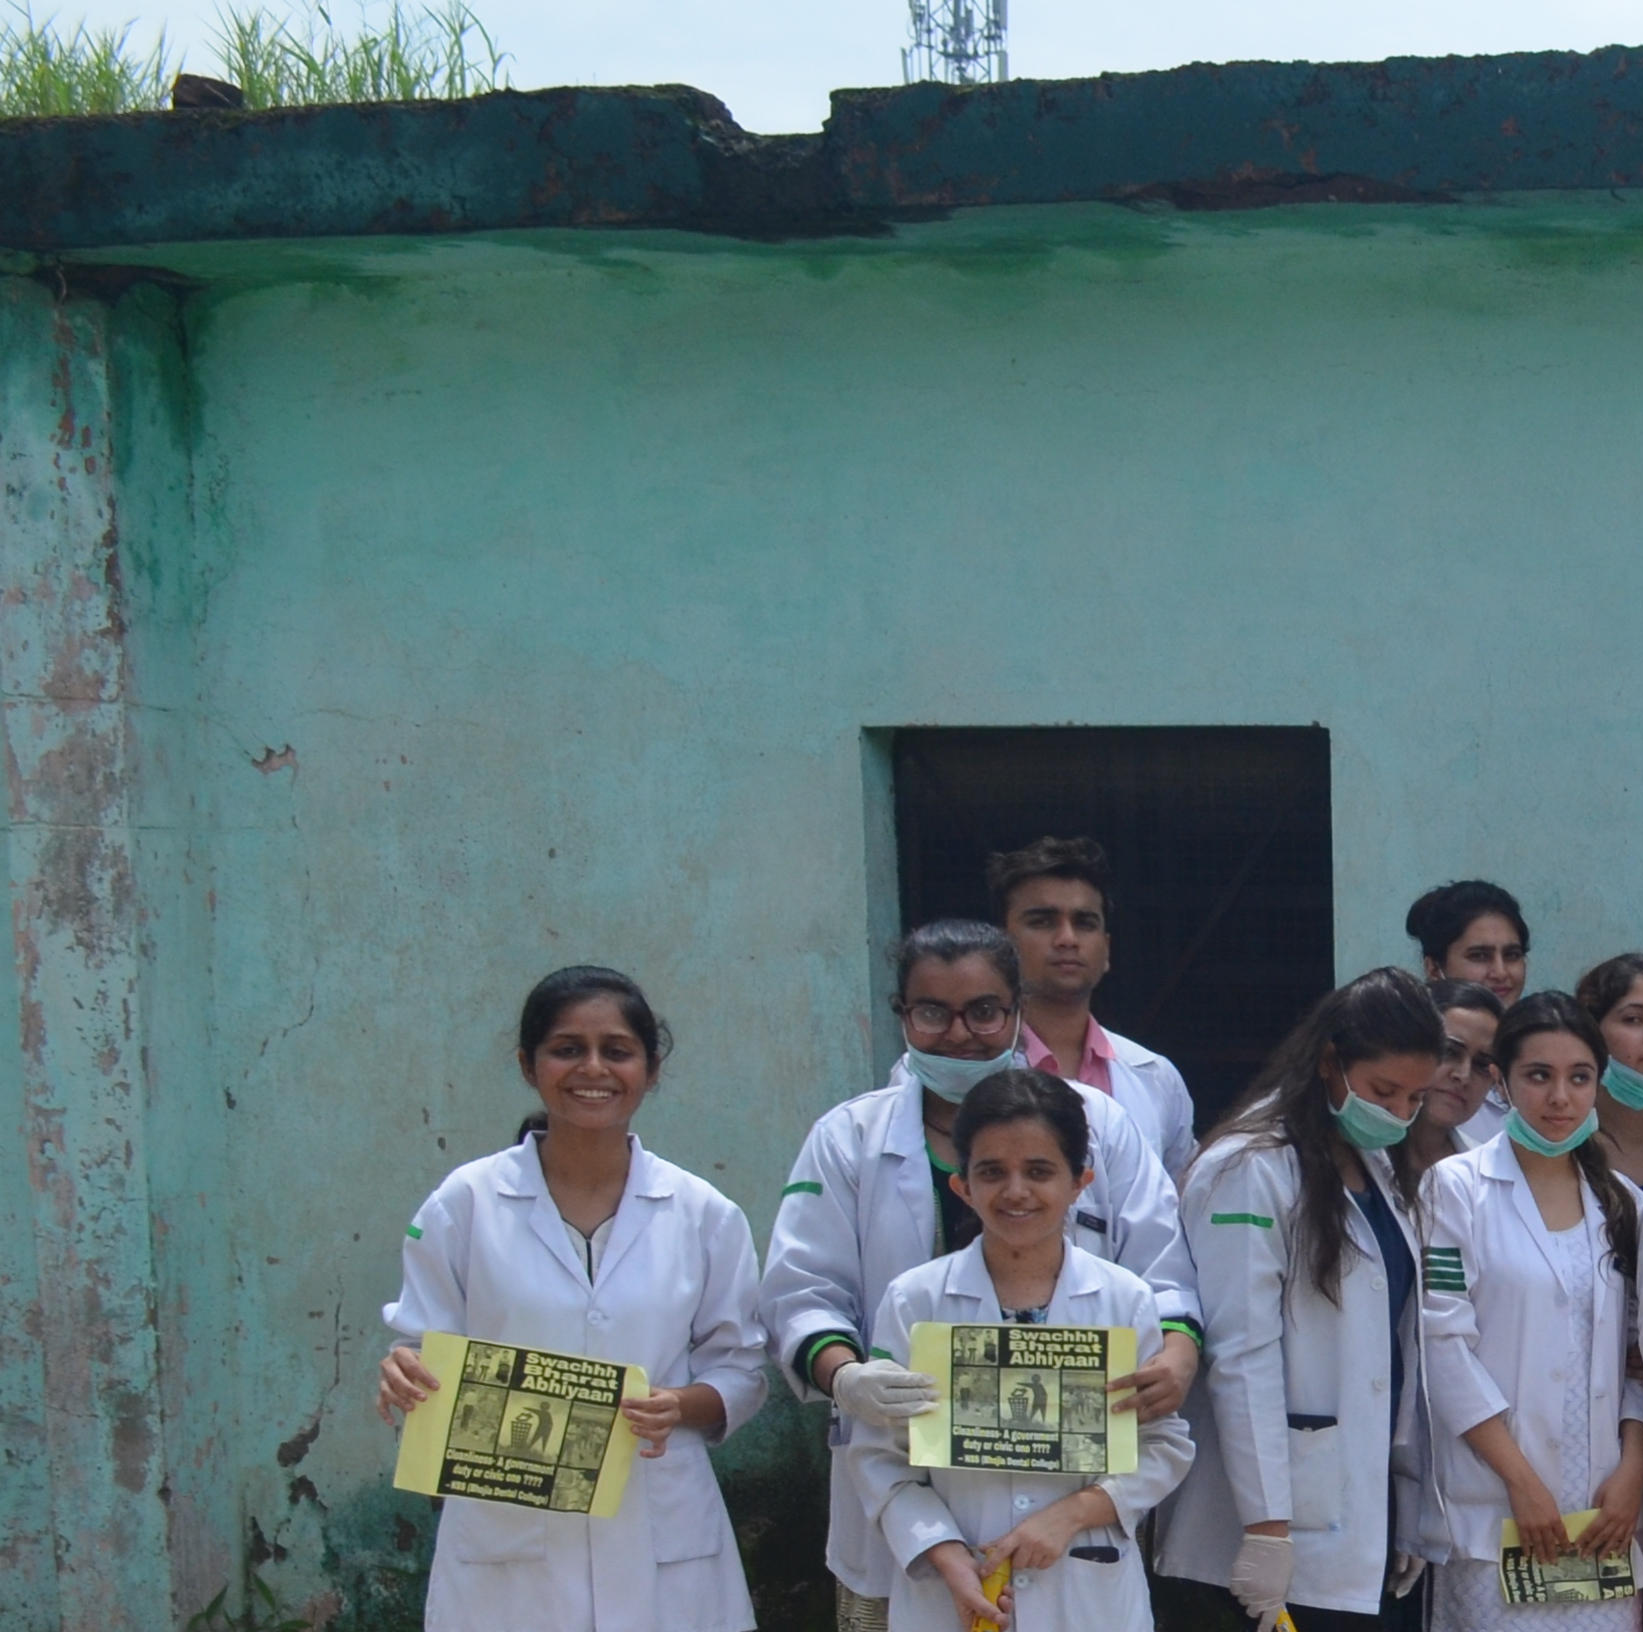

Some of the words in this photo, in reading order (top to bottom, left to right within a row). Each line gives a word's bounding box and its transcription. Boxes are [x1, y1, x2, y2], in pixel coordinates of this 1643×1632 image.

[1009, 1328, 1100, 1342] Swachhh
[1009, 1340, 1103, 1354] Bharat
[525, 1352, 618, 1378] Swachhh
[1009, 1350, 1100, 1370] Abhiyaan
[523, 1363, 619, 1390] Bharat
[520, 1375, 614, 1404] Abhiyaan
